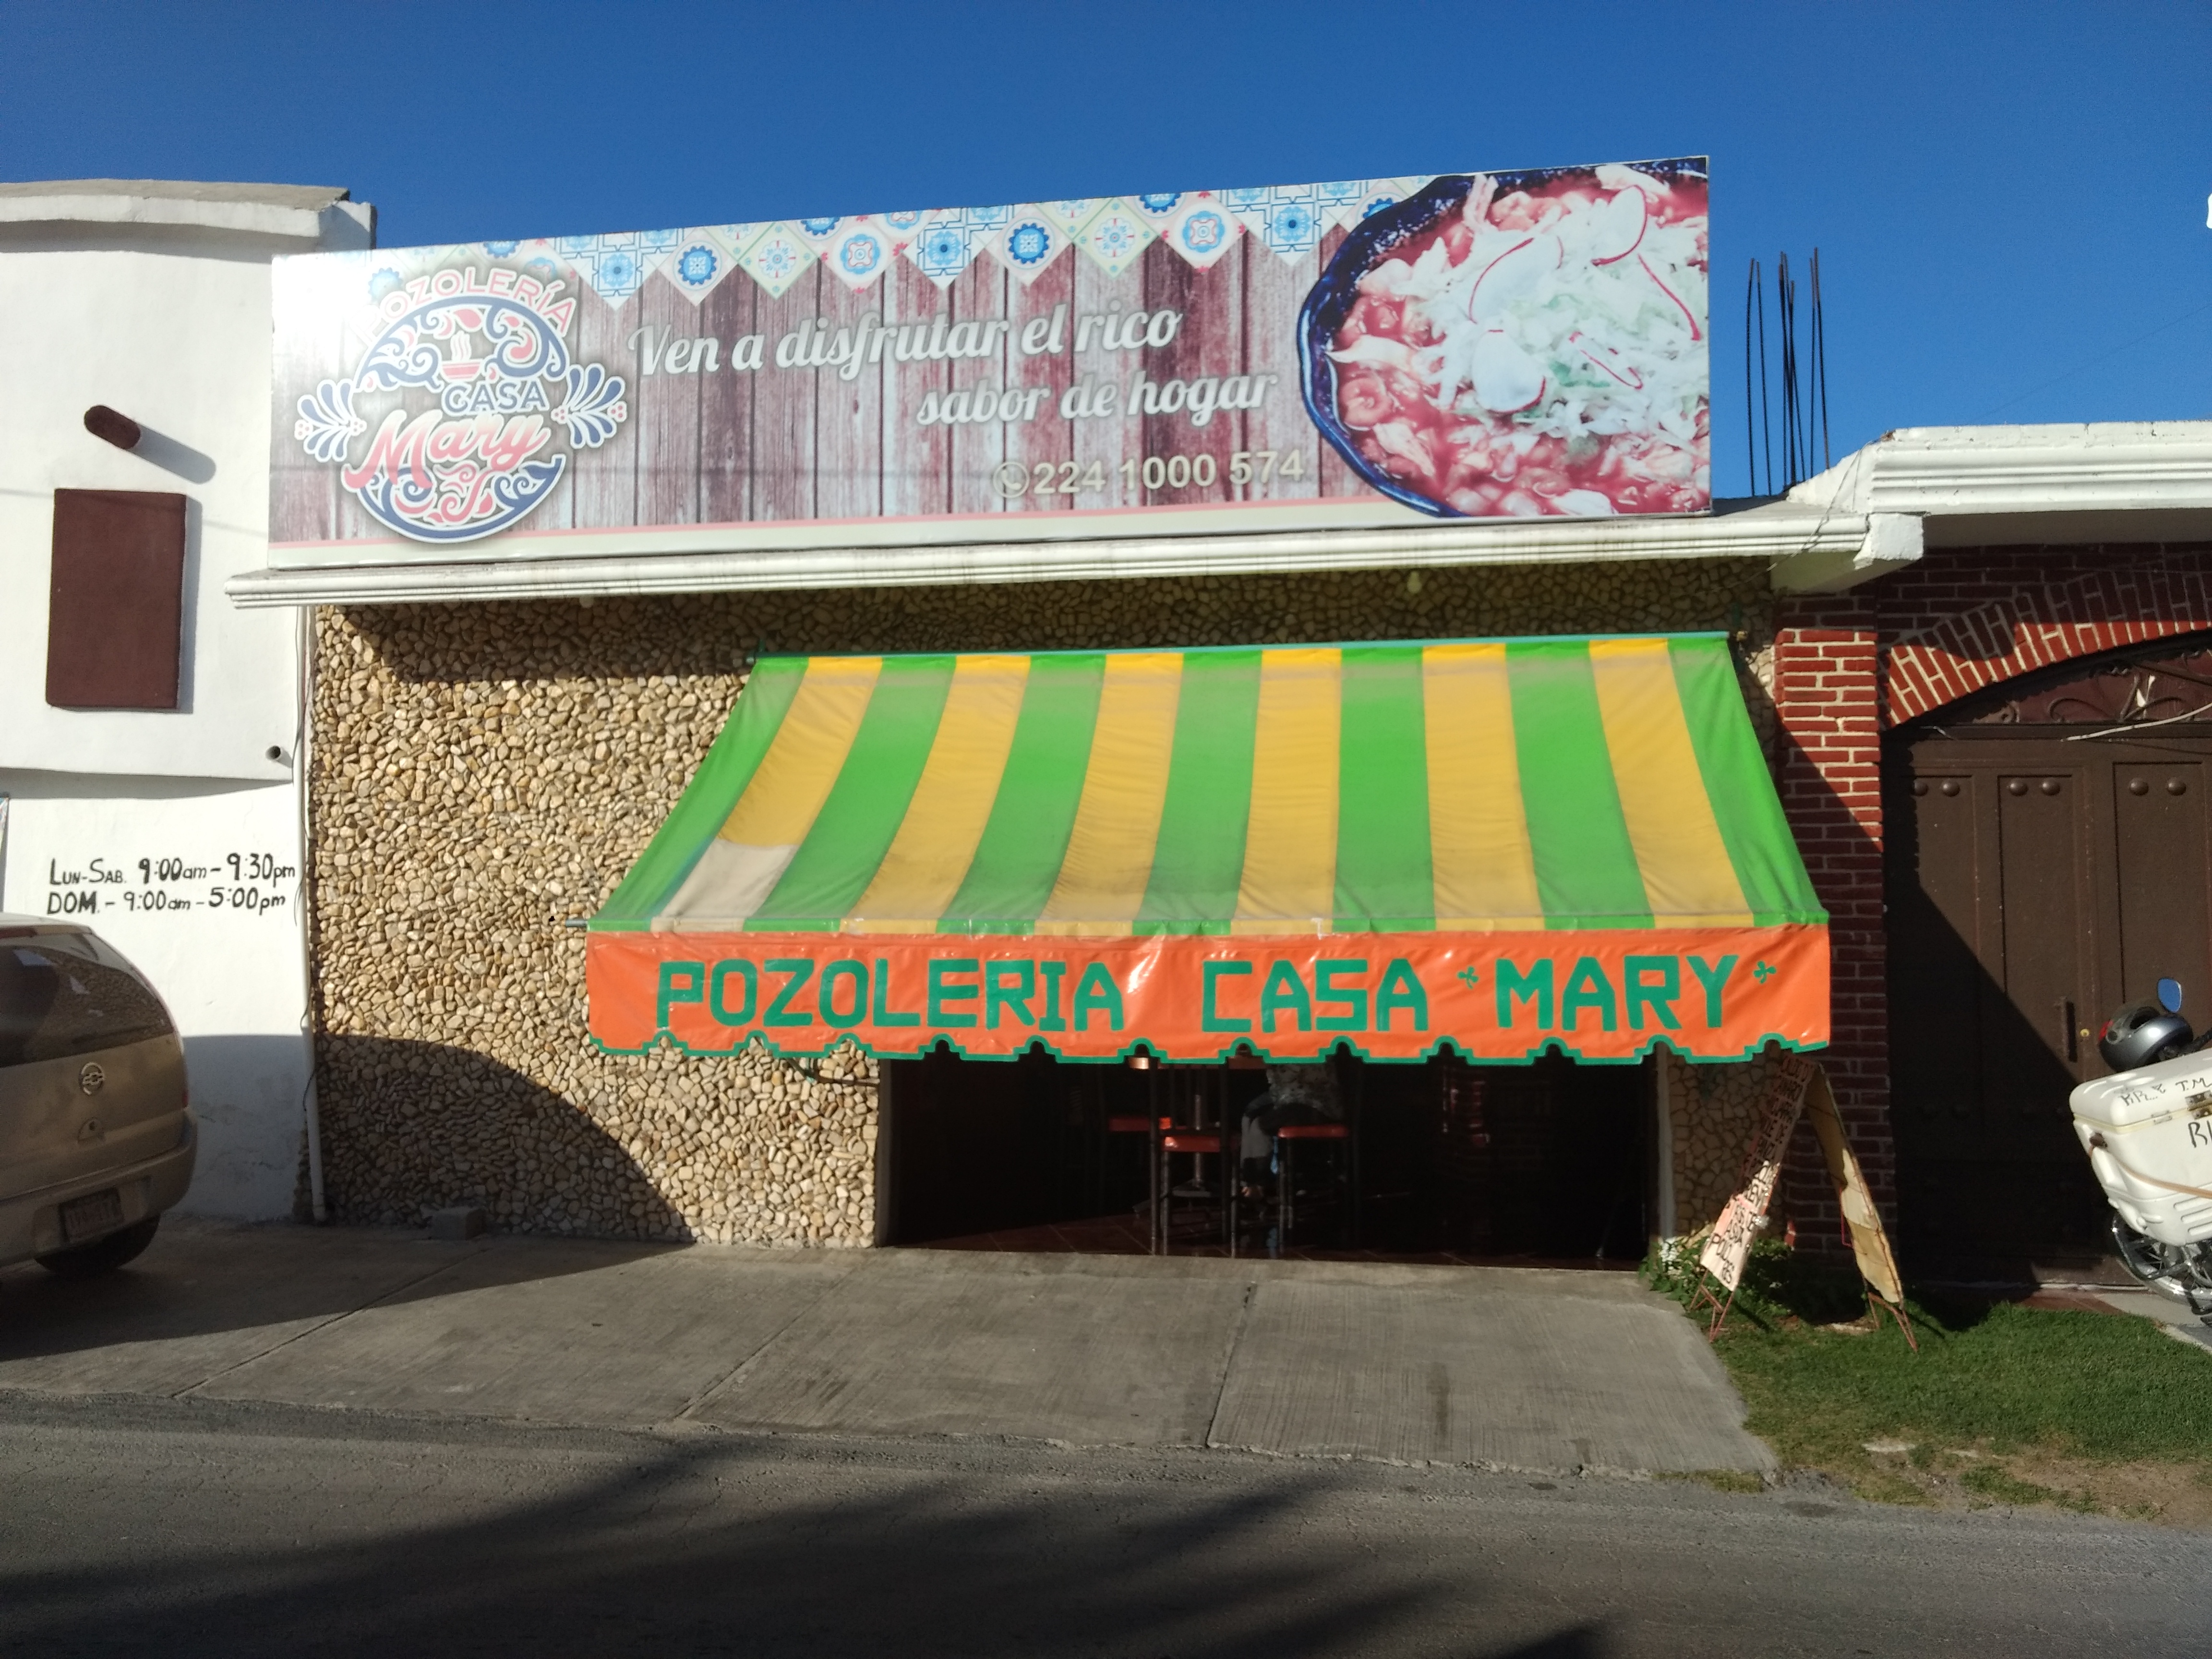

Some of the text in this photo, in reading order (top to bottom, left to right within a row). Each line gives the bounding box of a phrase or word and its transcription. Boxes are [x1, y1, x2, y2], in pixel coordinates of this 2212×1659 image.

[349, 267, 576, 347] POZOLERÍA
[628, 300, 1184, 381] Ven a disfrutar el rico
[443, 381, 549, 413] CASA
[917, 370, 1278, 427] sabor de hogar
[342, 409, 551, 518] Mary
[1033, 449, 1304, 494] 224 1000 574
[657, 954, 1739, 1033] POZOLERIA CASA MARY
